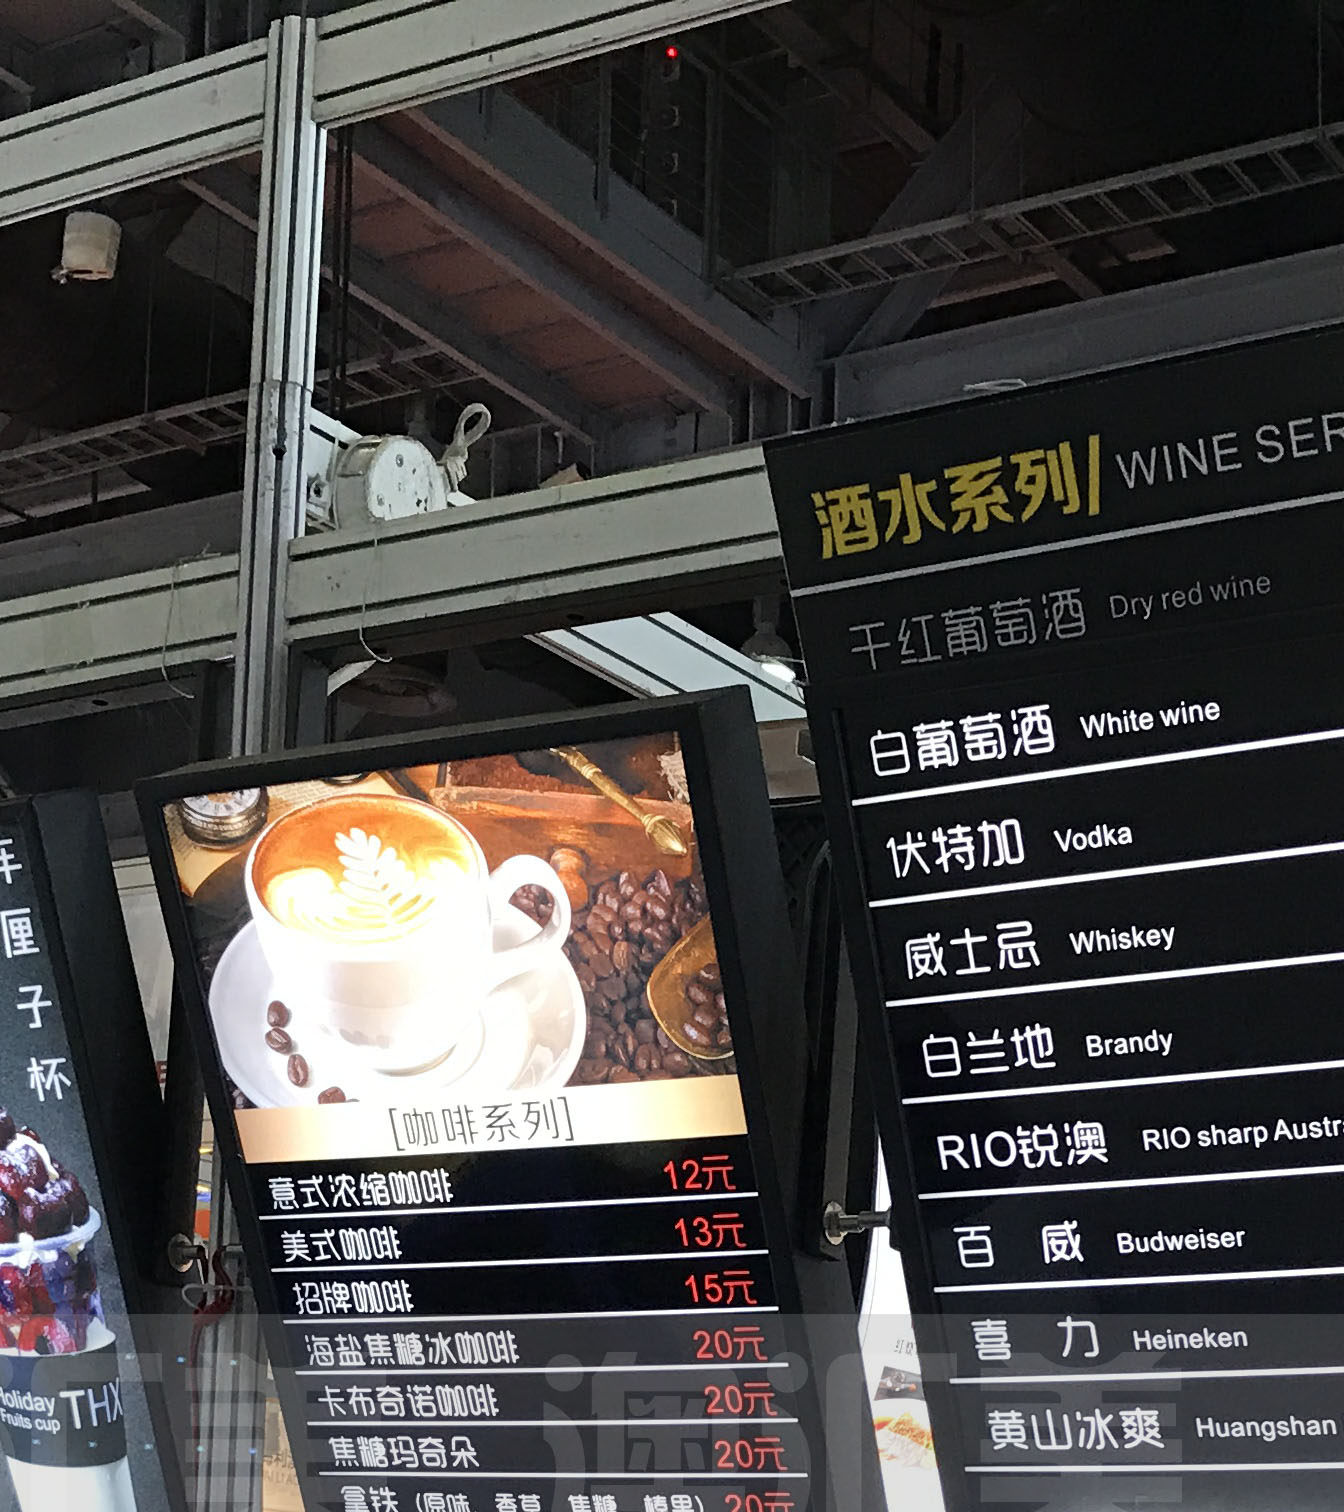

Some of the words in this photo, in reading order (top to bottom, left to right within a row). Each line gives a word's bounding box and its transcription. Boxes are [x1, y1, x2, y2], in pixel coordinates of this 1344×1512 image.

[1115, 431, 1243, 491] WINE
[849, 588, 1087, 672] 干红葡萄酒
[1109, 592, 1154, 622] Dry
[1161, 584, 1205, 612] red
[1210, 572, 1272, 604] wine
[869, 705, 1057, 777] 白葡萄酒
[1079, 706, 1158, 740] White
[1160, 697, 1222, 727] wine
[887, 818, 1026, 879] 伏特加
[1054, 824, 1134, 854] Vodka
[904, 920, 1041, 980] 威士忌
[1068, 923, 1177, 956] Whiskey
[921, 1022, 1057, 1079] 白兰地
[1085, 1028, 1174, 1060] Brandy
[937, 1120, 1109, 1173] RIO锐澳
[1142, 1123, 1192, 1153] RIO
[1197, 1118, 1270, 1153] sharp
[267, 1168, 455, 1210] 意式浓缩咖啡
[663, 1155, 736, 1191] 12元
[280, 1224, 403, 1263] 美式咖啡
[673, 1212, 748, 1248] 13元
[1117, 1225, 1246, 1254] Budweiser
[292, 1280, 415, 1316] 招牌咖啡
[684, 1270, 758, 1306] 15元
[304, 1330, 520, 1369] 海盐焦糖冰咖啡
[692, 1326, 769, 1362] 20元
[1133, 1324, 1249, 1352] Heineken
[0, 1408, 32, 1431] Fruits
[34, 1414, 62, 1435] cup
[317, 1384, 500, 1419] 卡布奇诺咖啡
[704, 1382, 779, 1417] 20元
[327, 1435, 480, 1469] 焦糖玛奇朵
[714, 1437, 789, 1472] 20元
[987, 1407, 1166, 1453] 黄山冰爽
[1196, 1414, 1338, 1442] Huangshan
